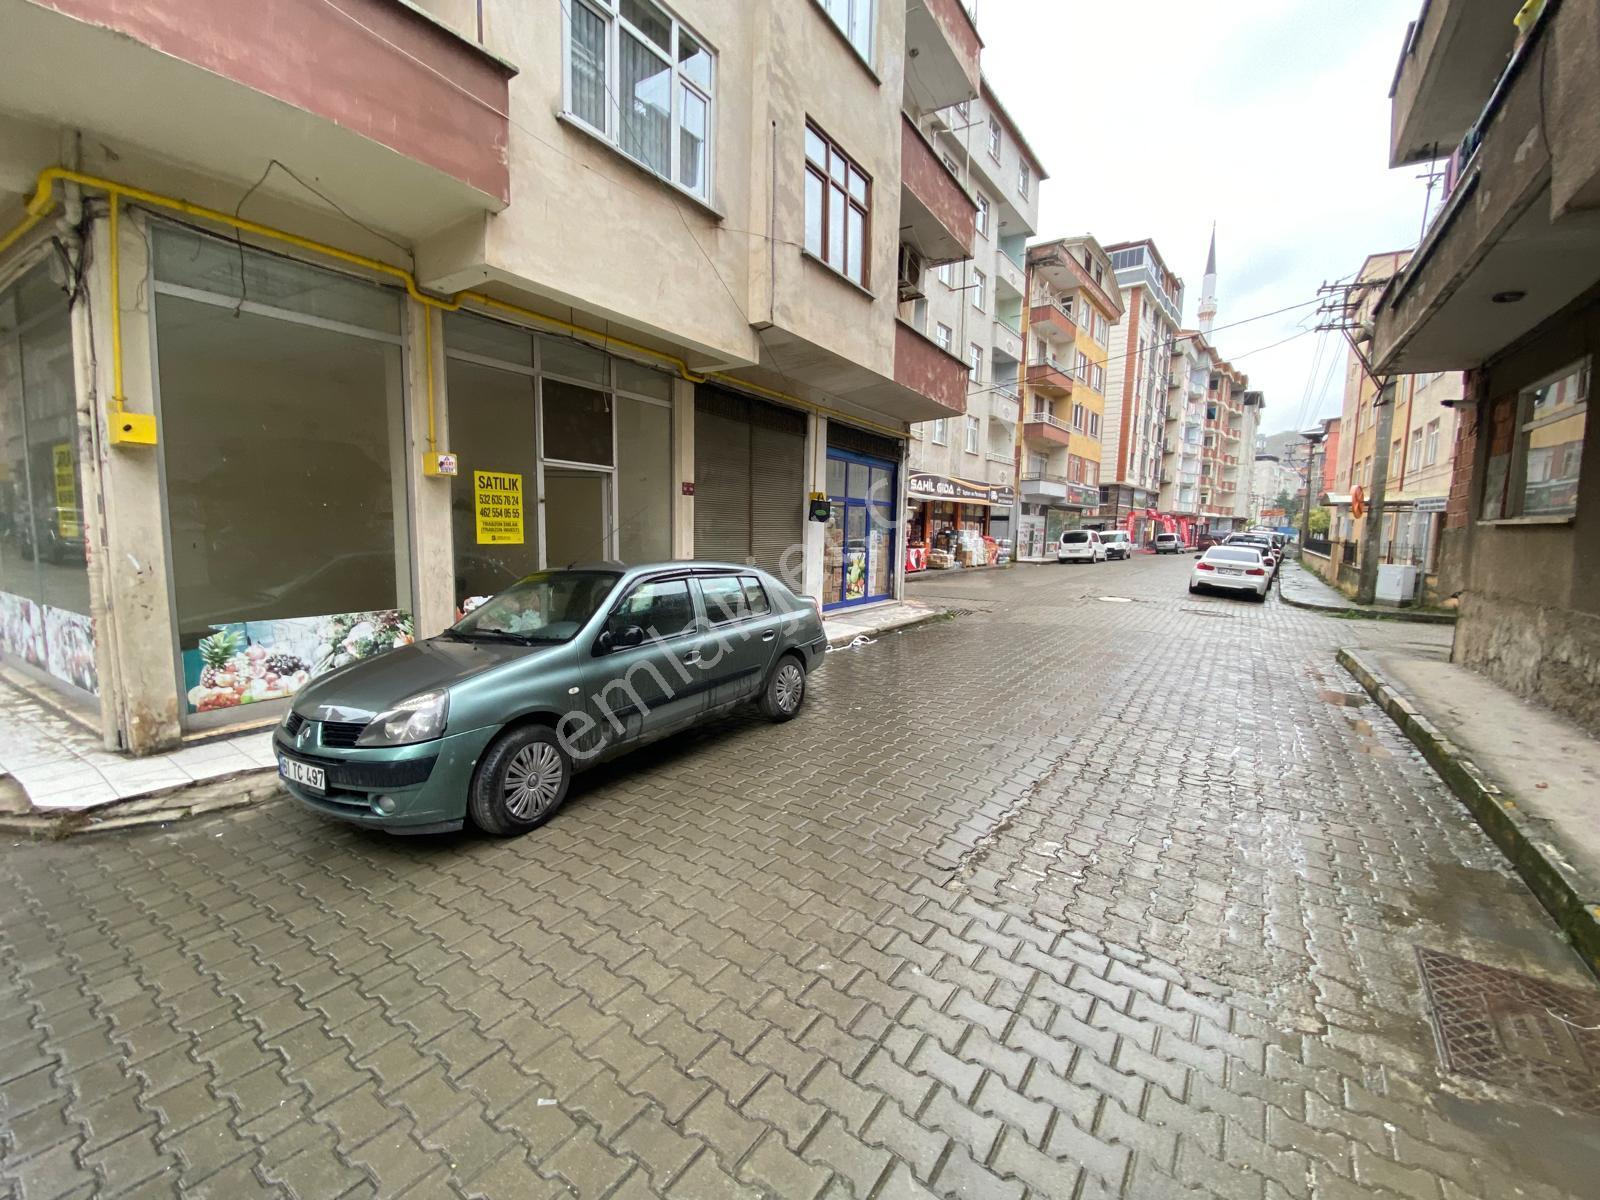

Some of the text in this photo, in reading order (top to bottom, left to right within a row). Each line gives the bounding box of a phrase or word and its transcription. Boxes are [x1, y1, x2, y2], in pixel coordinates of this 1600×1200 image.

[478, 475, 519, 491] SATILIK
[910, 478, 935, 492] SAHİL
[479, 494, 490, 504] 532
[491, 495, 502, 505] 635
[511, 496, 519, 506] 24
[480, 507, 490, 518] 462
[491, 507, 503, 518] 554
[511, 508, 520, 518] 55
[292, 762, 304, 781] TC
[306, 766, 324, 788] 497
